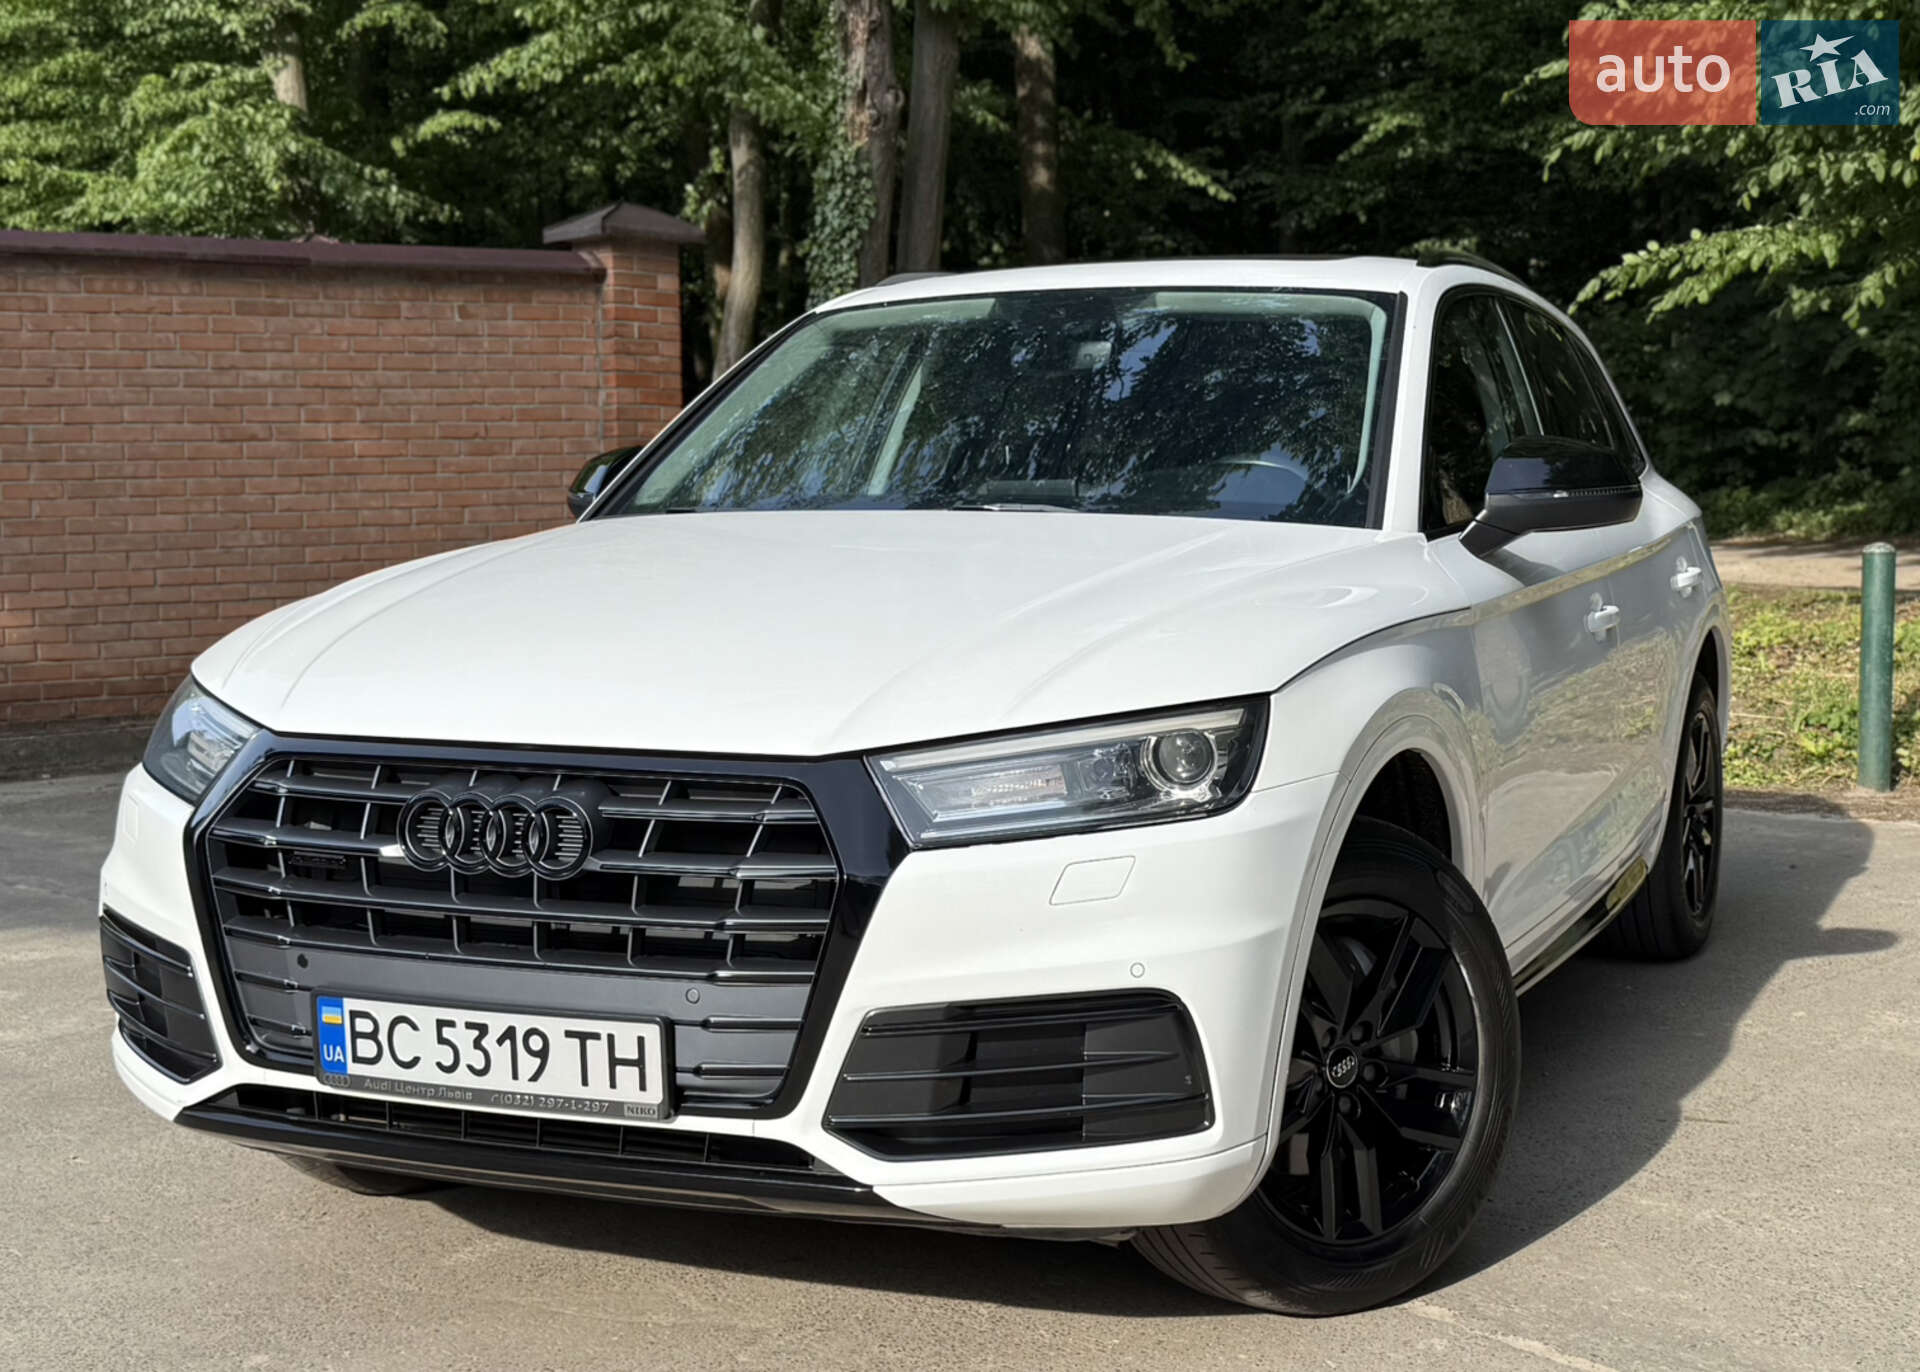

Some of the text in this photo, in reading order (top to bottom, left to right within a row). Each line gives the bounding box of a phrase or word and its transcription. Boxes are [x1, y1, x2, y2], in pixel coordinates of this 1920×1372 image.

[322, 1044, 346, 1064] UA
[348, 1008, 648, 1092] BC 5319 TH
[364, 1078, 392, 1092] Audi
[539, 1097, 609, 1113] 297-1-297
